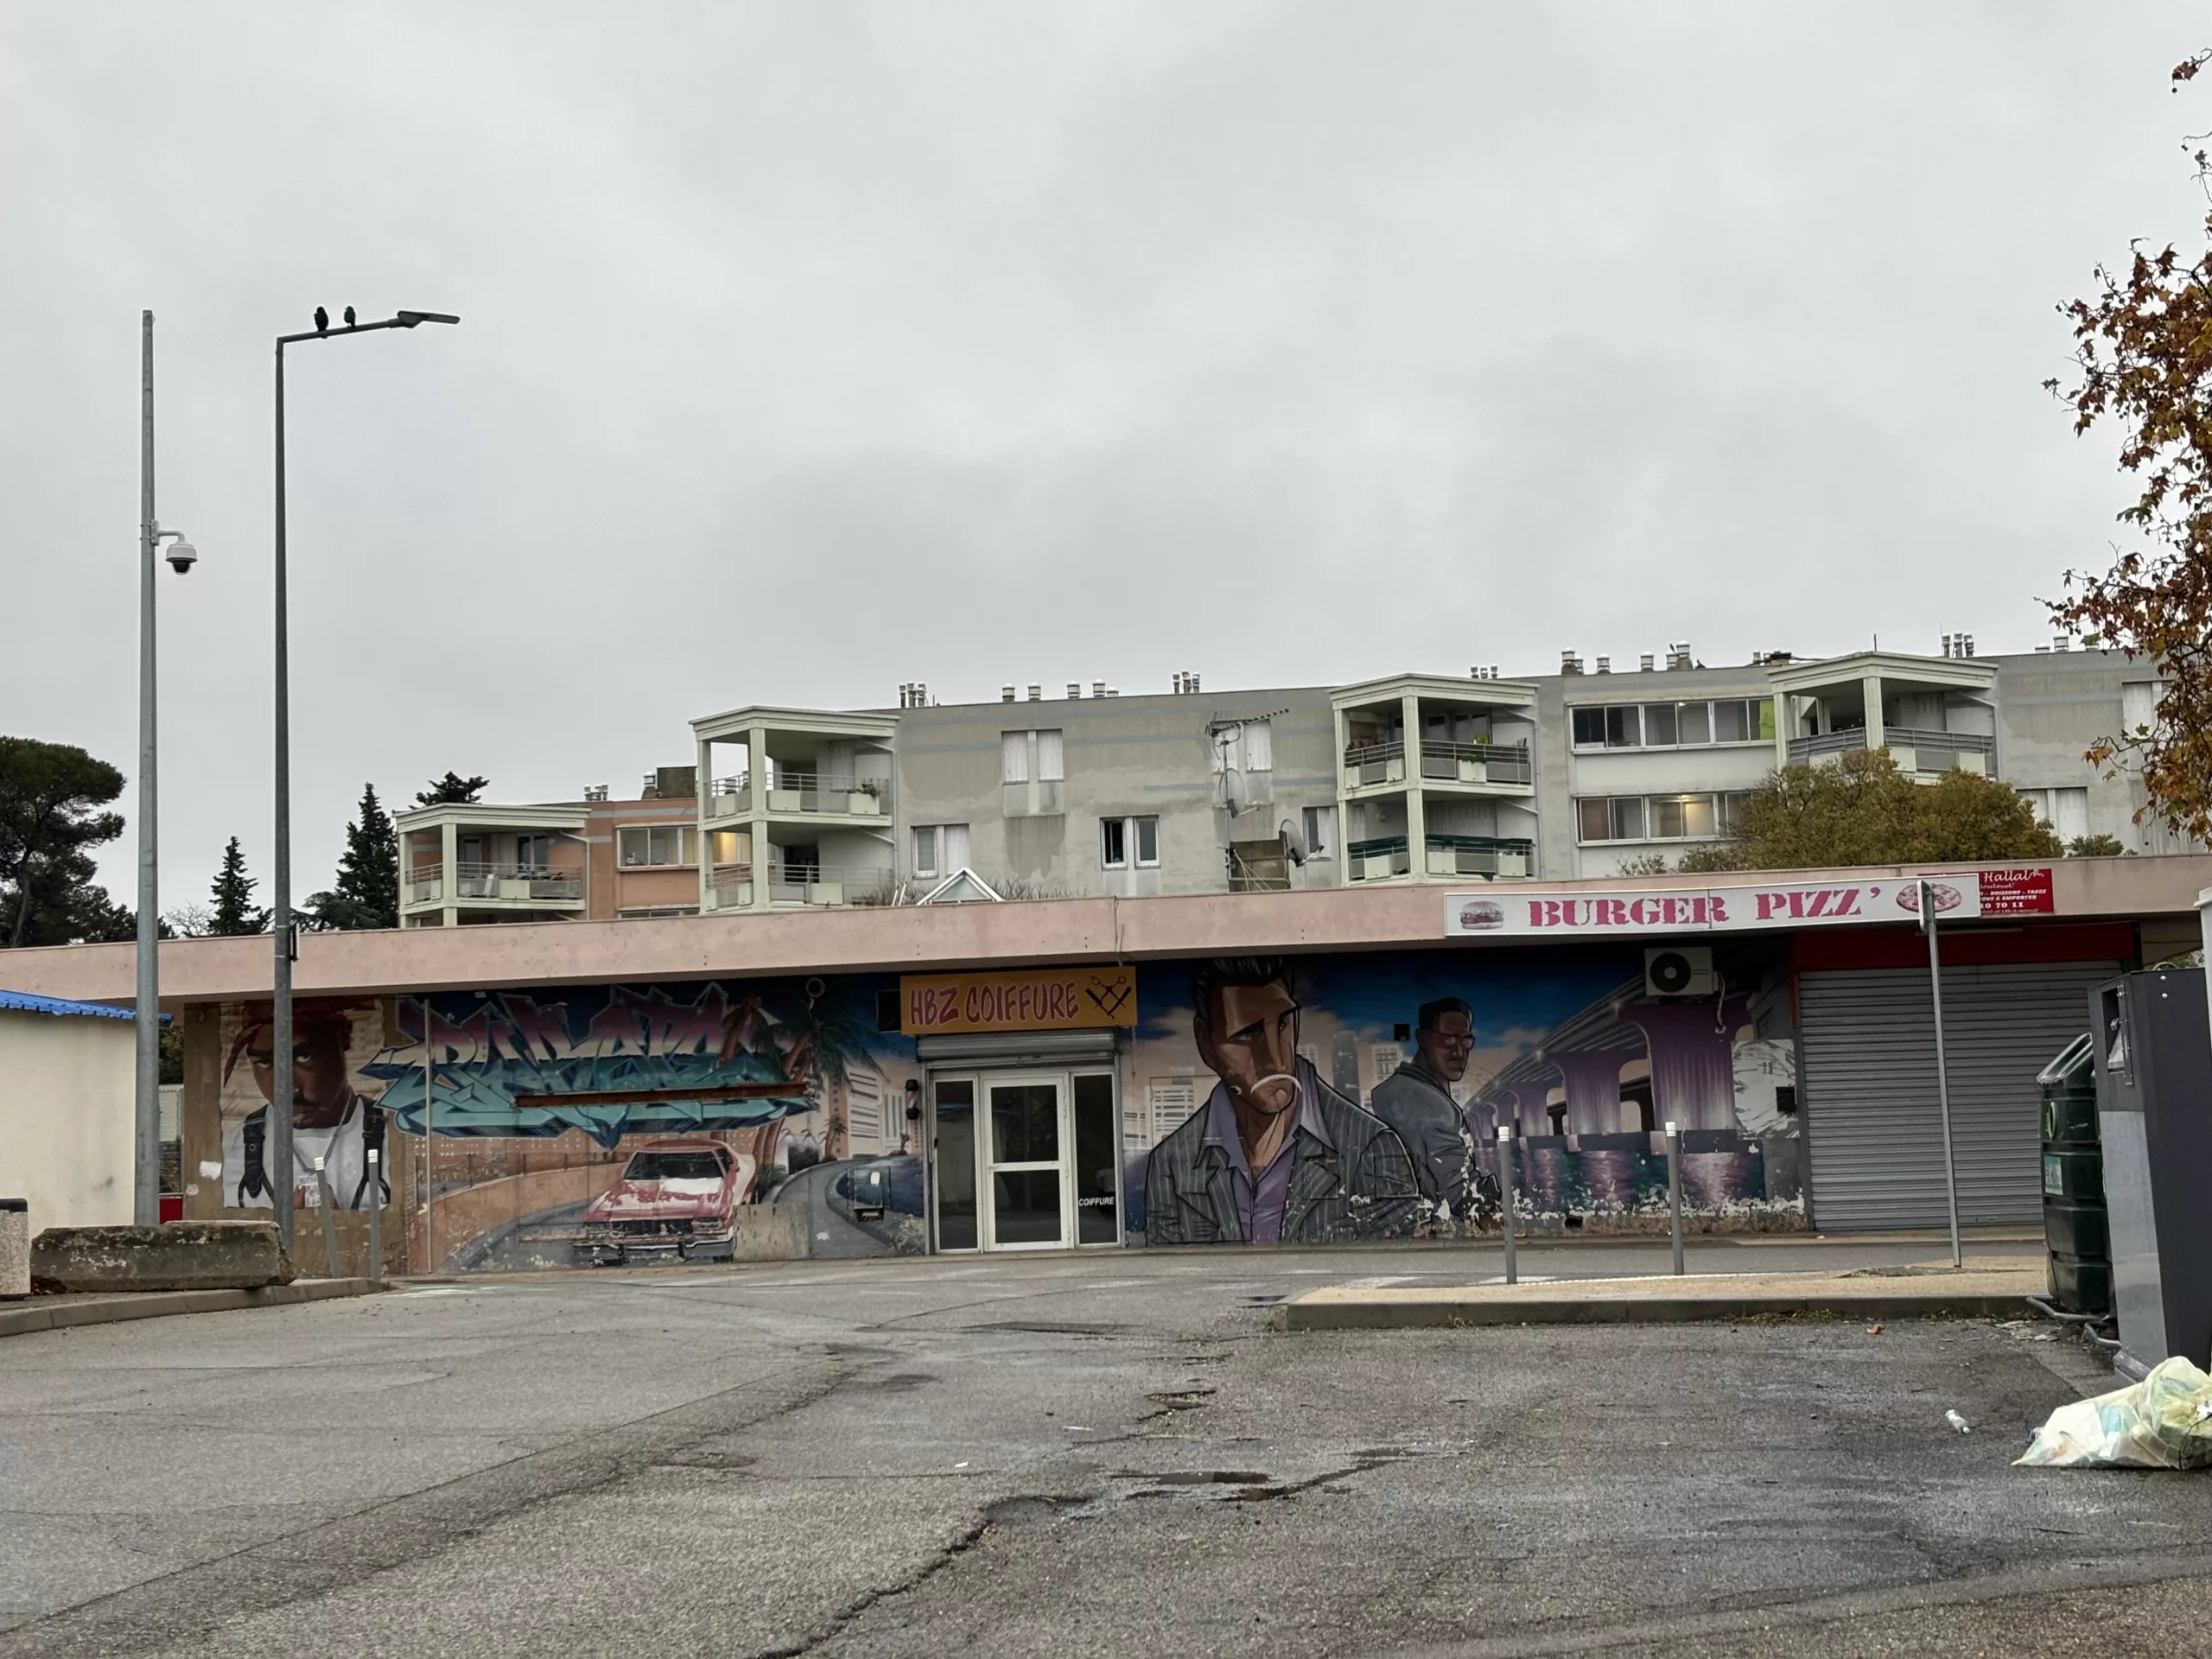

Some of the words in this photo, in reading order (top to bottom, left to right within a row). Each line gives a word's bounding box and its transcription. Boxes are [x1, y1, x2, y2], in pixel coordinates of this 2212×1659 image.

[1528, 898, 1729, 927] BURGER
[910, 987, 959, 1027] HBZ
[964, 981, 1080, 1024] COIFFURE
[1078, 1196, 1115, 1207] COIFFURE
